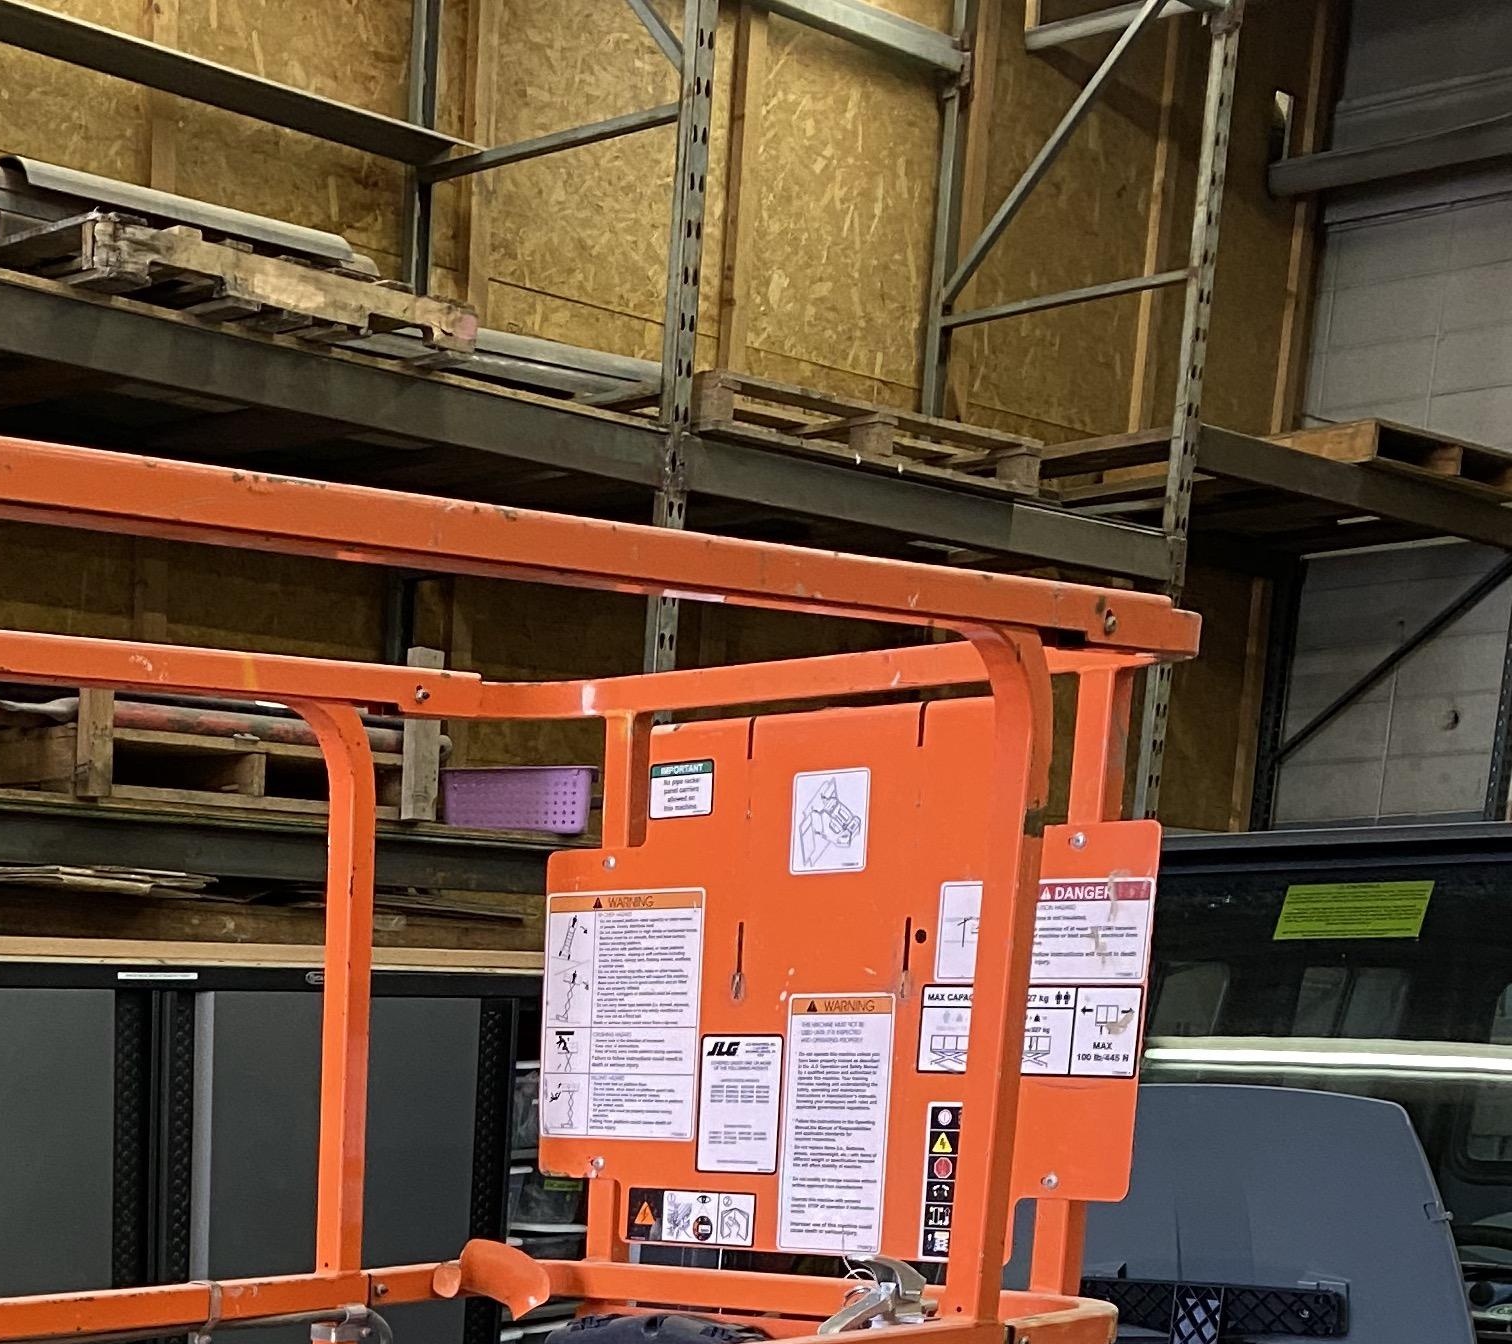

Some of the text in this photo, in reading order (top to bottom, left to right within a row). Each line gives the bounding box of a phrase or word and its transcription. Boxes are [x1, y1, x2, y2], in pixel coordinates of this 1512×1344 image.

[661, 764, 704, 776] IMPORTANT
[607, 895, 654, 908] WARNING
[927, 993, 1049, 1004] MAX CAPAC kg
[824, 1000, 876, 1012] WARNING
[706, 1041, 741, 1057] JLG
[1092, 1041, 1113, 1050] MAX
[1077, 1053, 1092, 1062] 100
